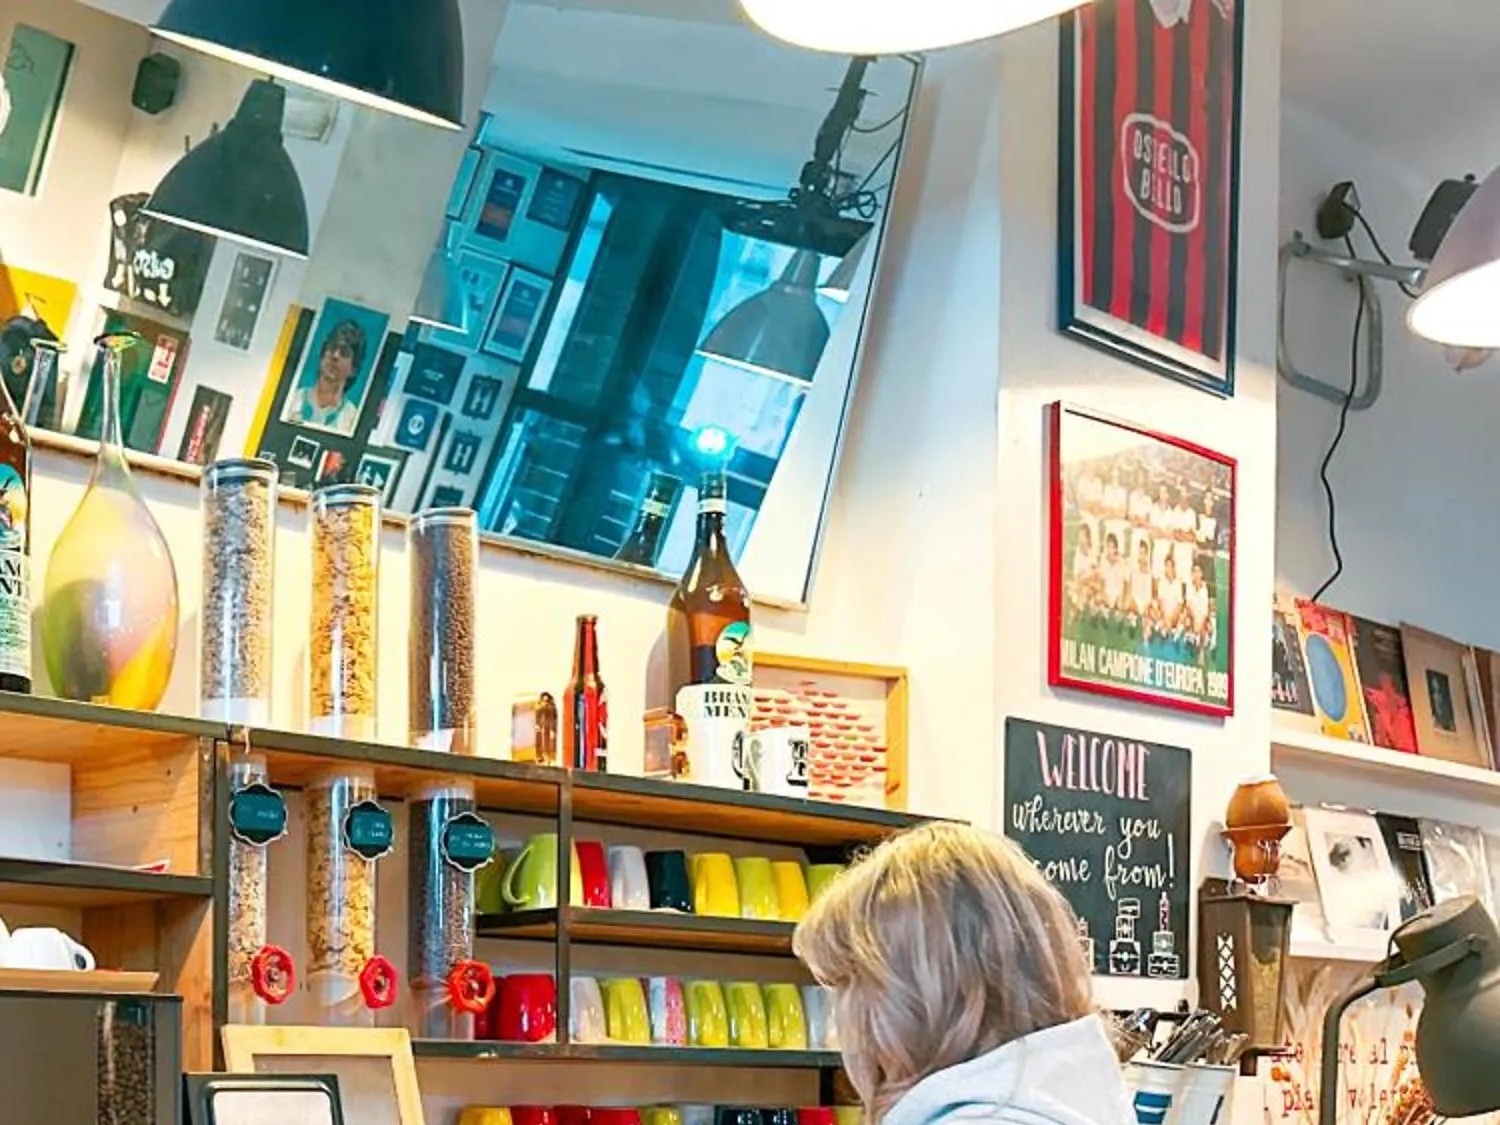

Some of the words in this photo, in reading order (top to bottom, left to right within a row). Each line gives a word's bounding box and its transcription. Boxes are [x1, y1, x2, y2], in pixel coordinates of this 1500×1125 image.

[1036, 730, 1151, 800] WELCOME
[1104, 832, 1175, 901] from!
[1117, 816, 1162, 860] you
